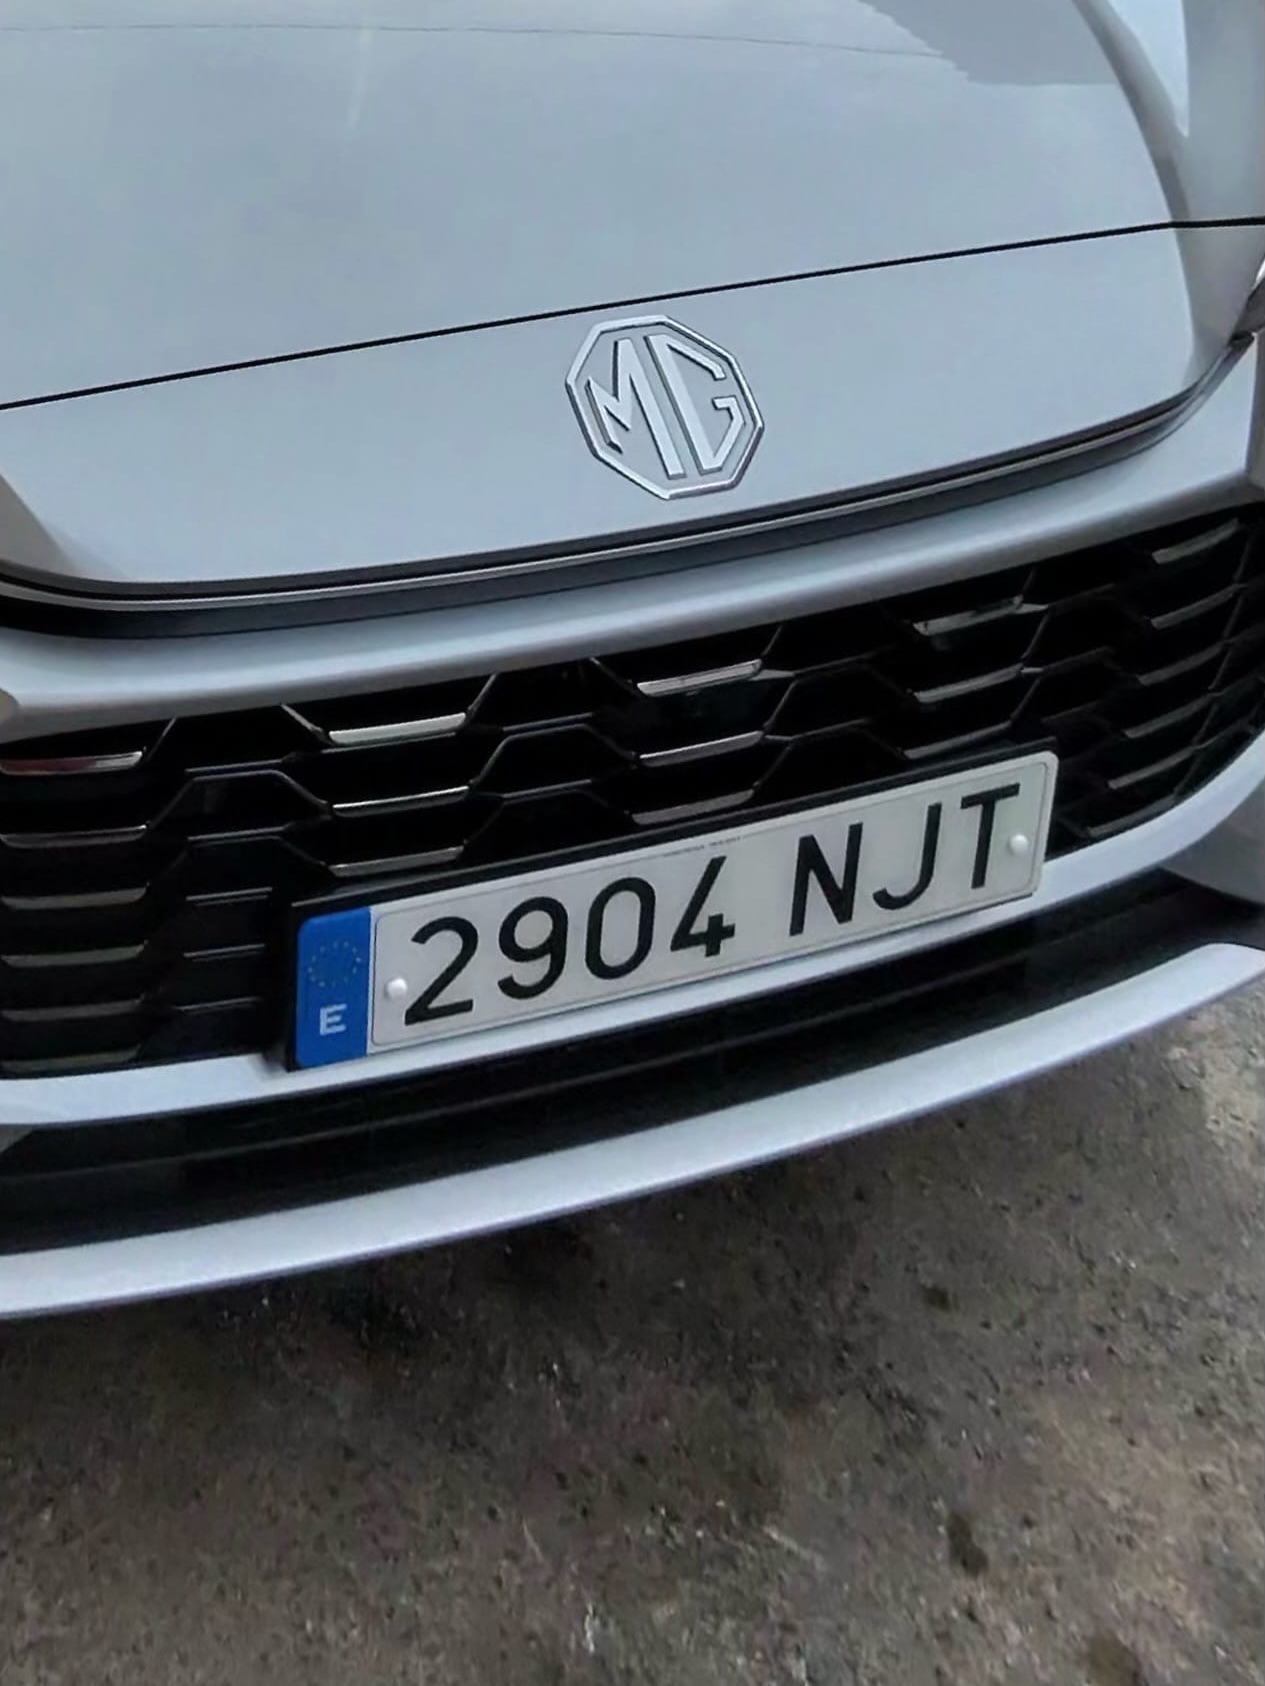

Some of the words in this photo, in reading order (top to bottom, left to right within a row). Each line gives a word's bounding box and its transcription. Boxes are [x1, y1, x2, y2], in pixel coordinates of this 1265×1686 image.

[586, 334, 745, 479] MG
[404, 855, 735, 1025] 2904
[789, 782, 1020, 936] NJT
[319, 1003, 347, 1036] E
